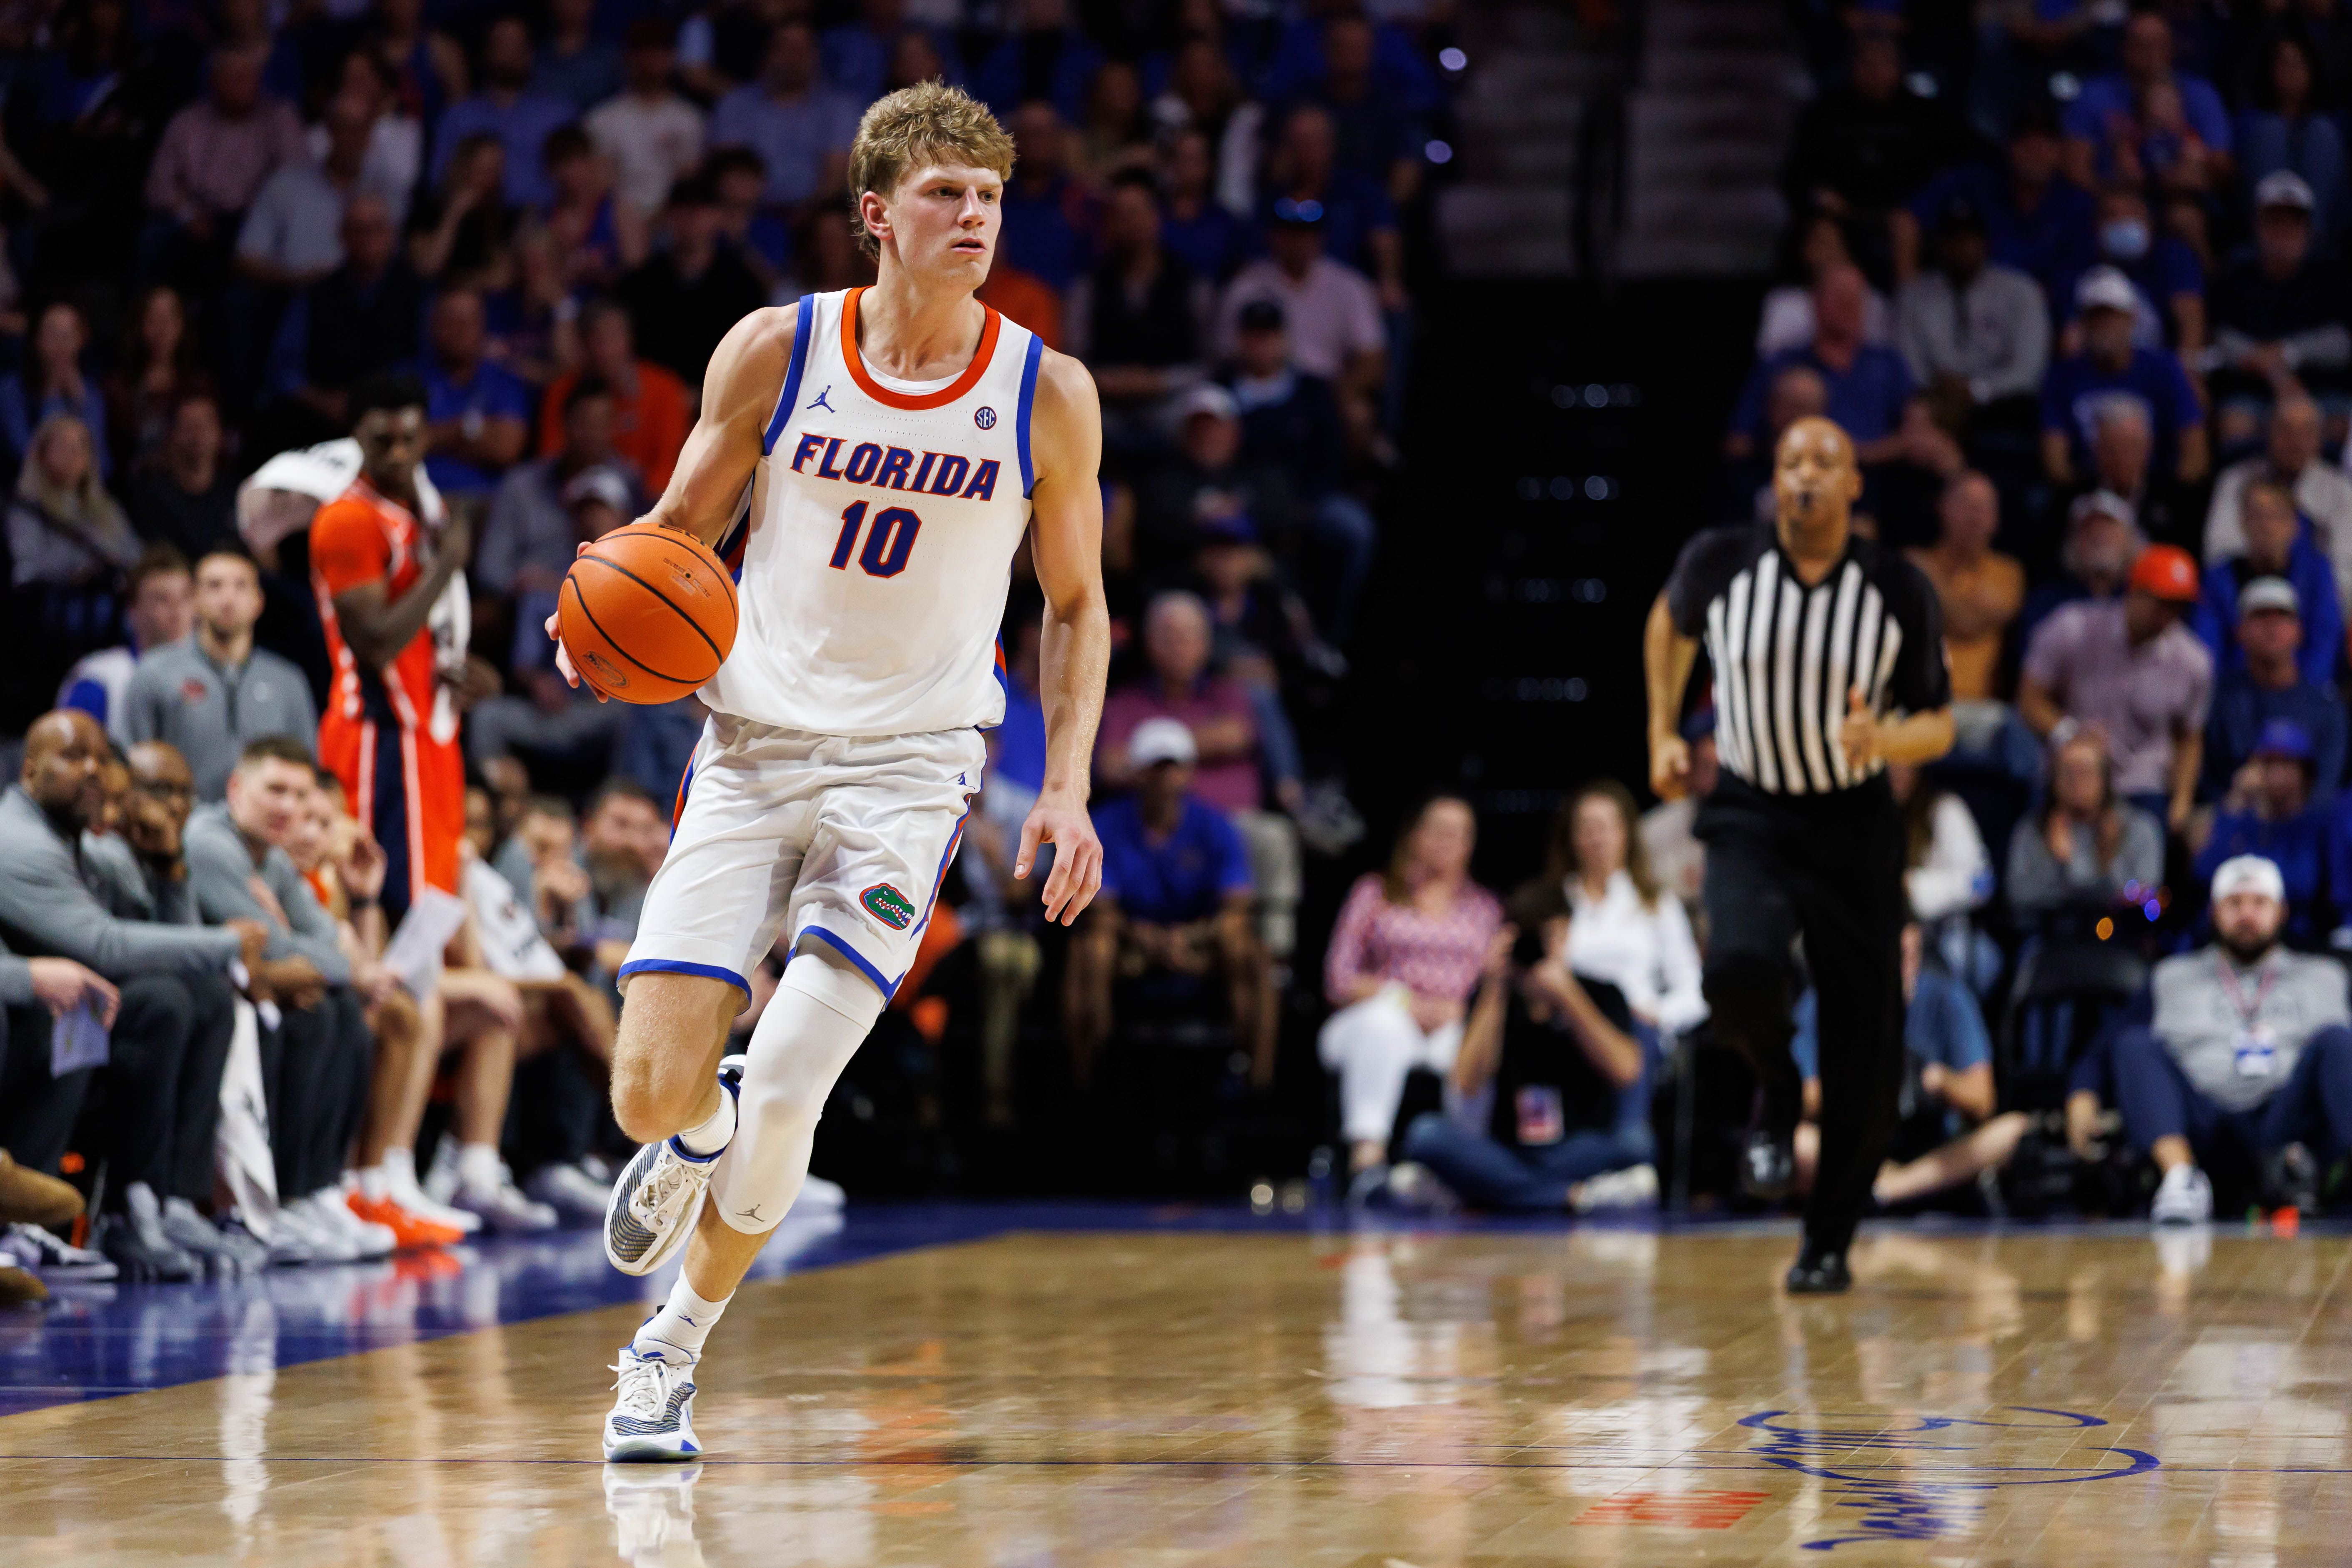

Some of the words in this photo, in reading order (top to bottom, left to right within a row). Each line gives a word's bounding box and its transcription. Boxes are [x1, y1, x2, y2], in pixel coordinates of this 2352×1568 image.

[977, 409, 995, 428] SEC
[790, 432, 1001, 501] FLORIDA
[829, 500, 923, 579] 10
